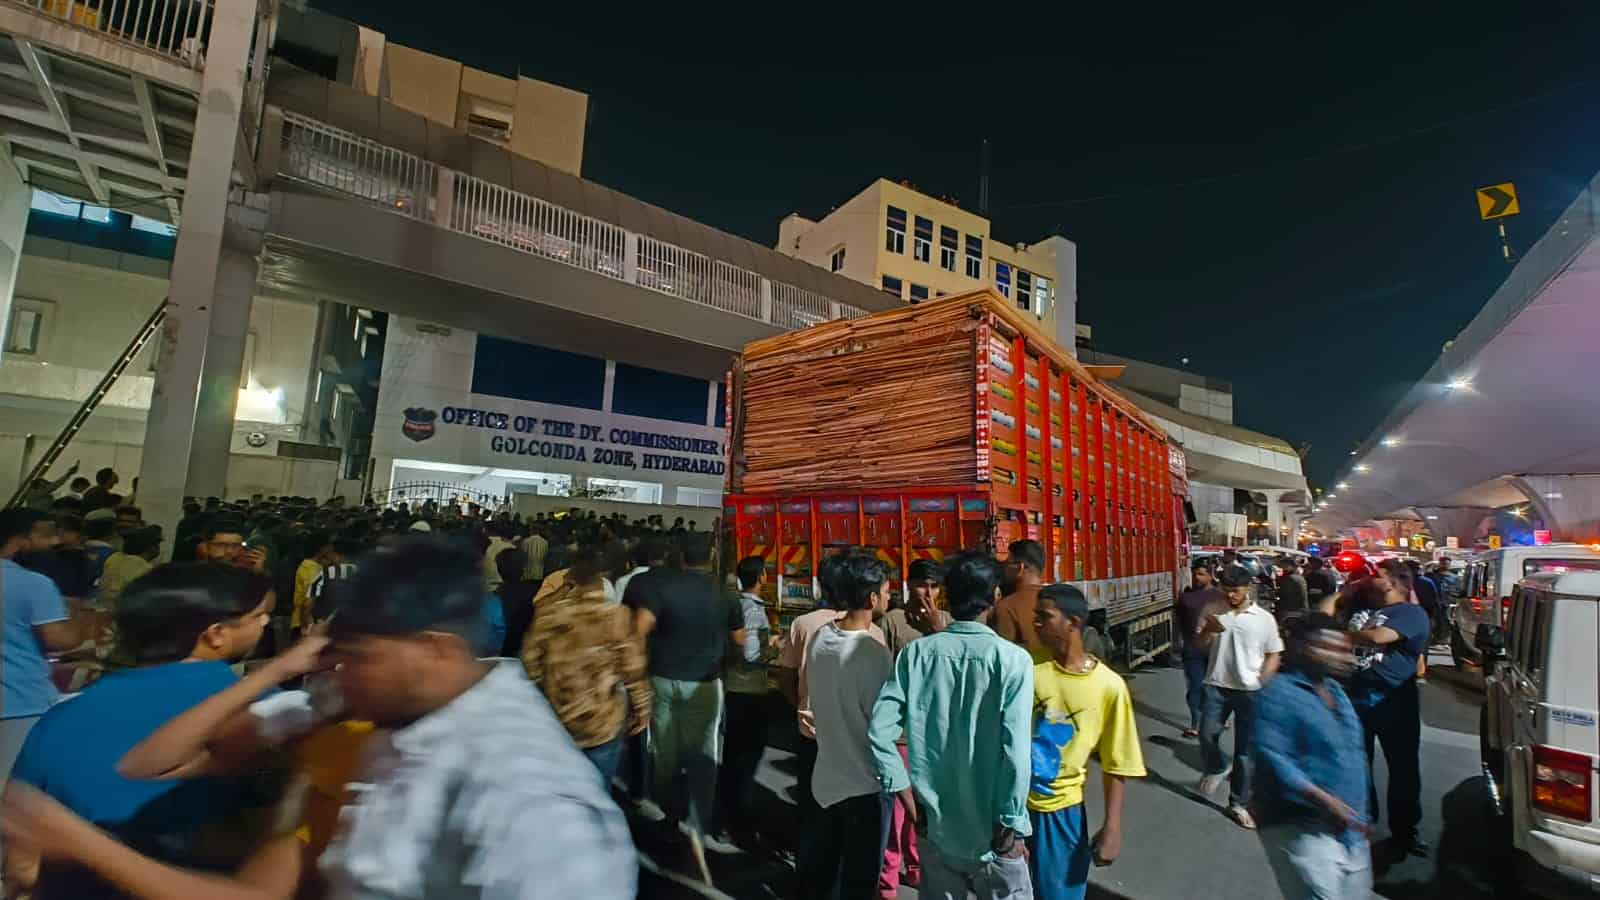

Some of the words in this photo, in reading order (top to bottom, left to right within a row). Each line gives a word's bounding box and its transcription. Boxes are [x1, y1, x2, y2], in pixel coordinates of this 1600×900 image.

[441, 406, 509, 430] OFFICE
[513, 415, 537, 433] OF
[542, 418, 576, 438] THE
[579, 423, 605, 442] DY.
[609, 428, 719, 456] COMMISSIONER
[491, 435, 586, 462] GOLCONDA
[593, 447, 637, 470] ZONE,
[642, 453, 725, 475] HYDERABAD
